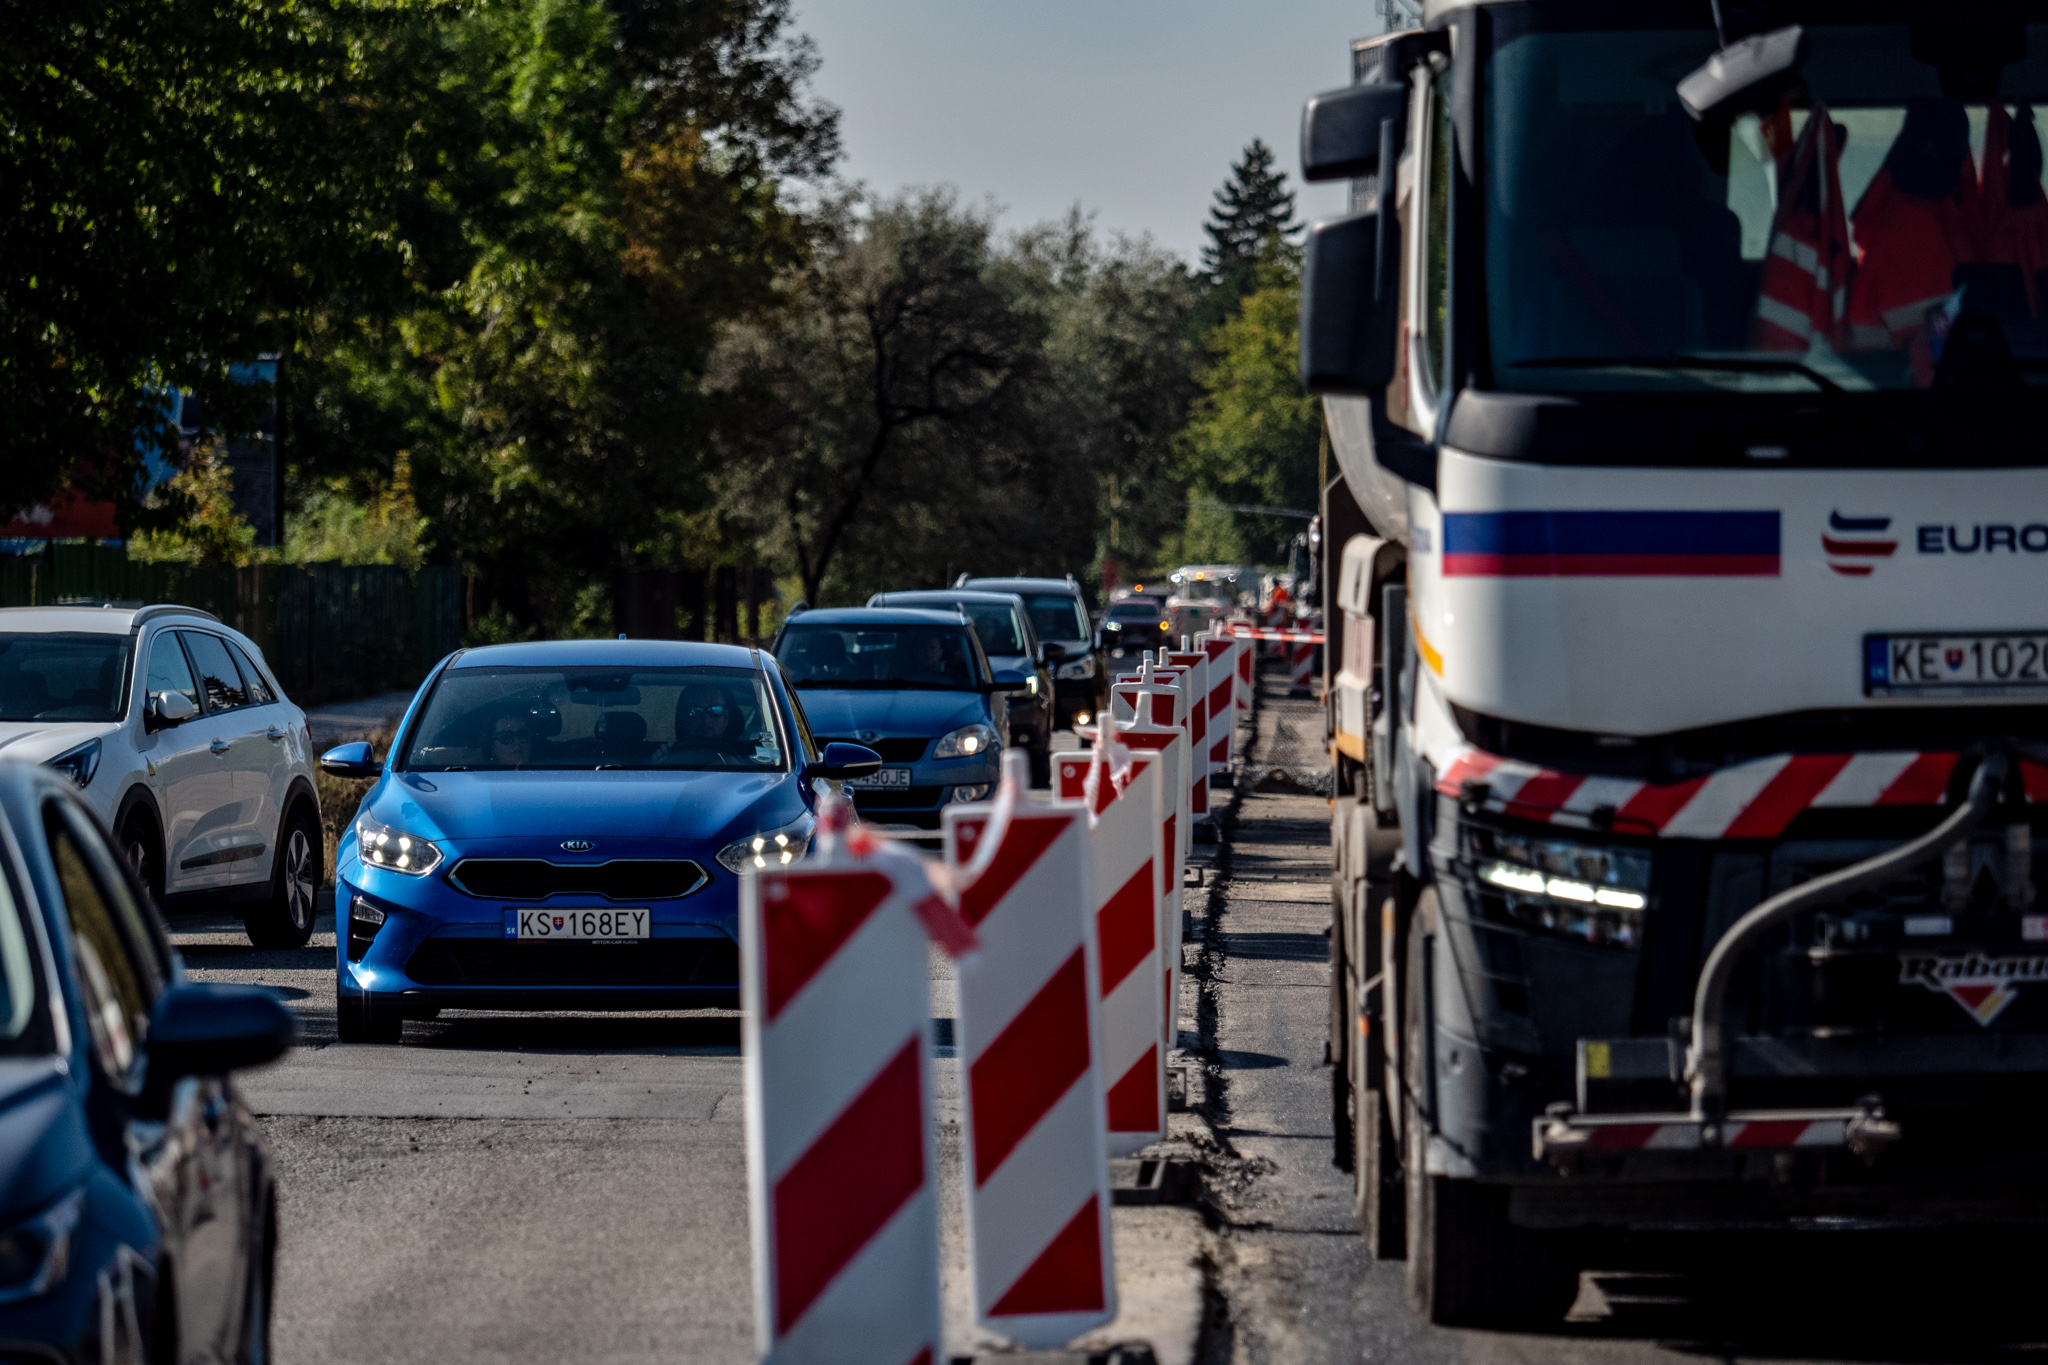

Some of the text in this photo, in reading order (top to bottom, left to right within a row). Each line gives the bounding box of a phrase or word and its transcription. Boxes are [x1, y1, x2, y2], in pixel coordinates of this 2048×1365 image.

[1917, 524, 2048, 554] EURO
[1893, 641, 2048, 681] KE 102
[567, 841, 589, 849] KIA
[520, 912, 645, 936] KS 168EY
